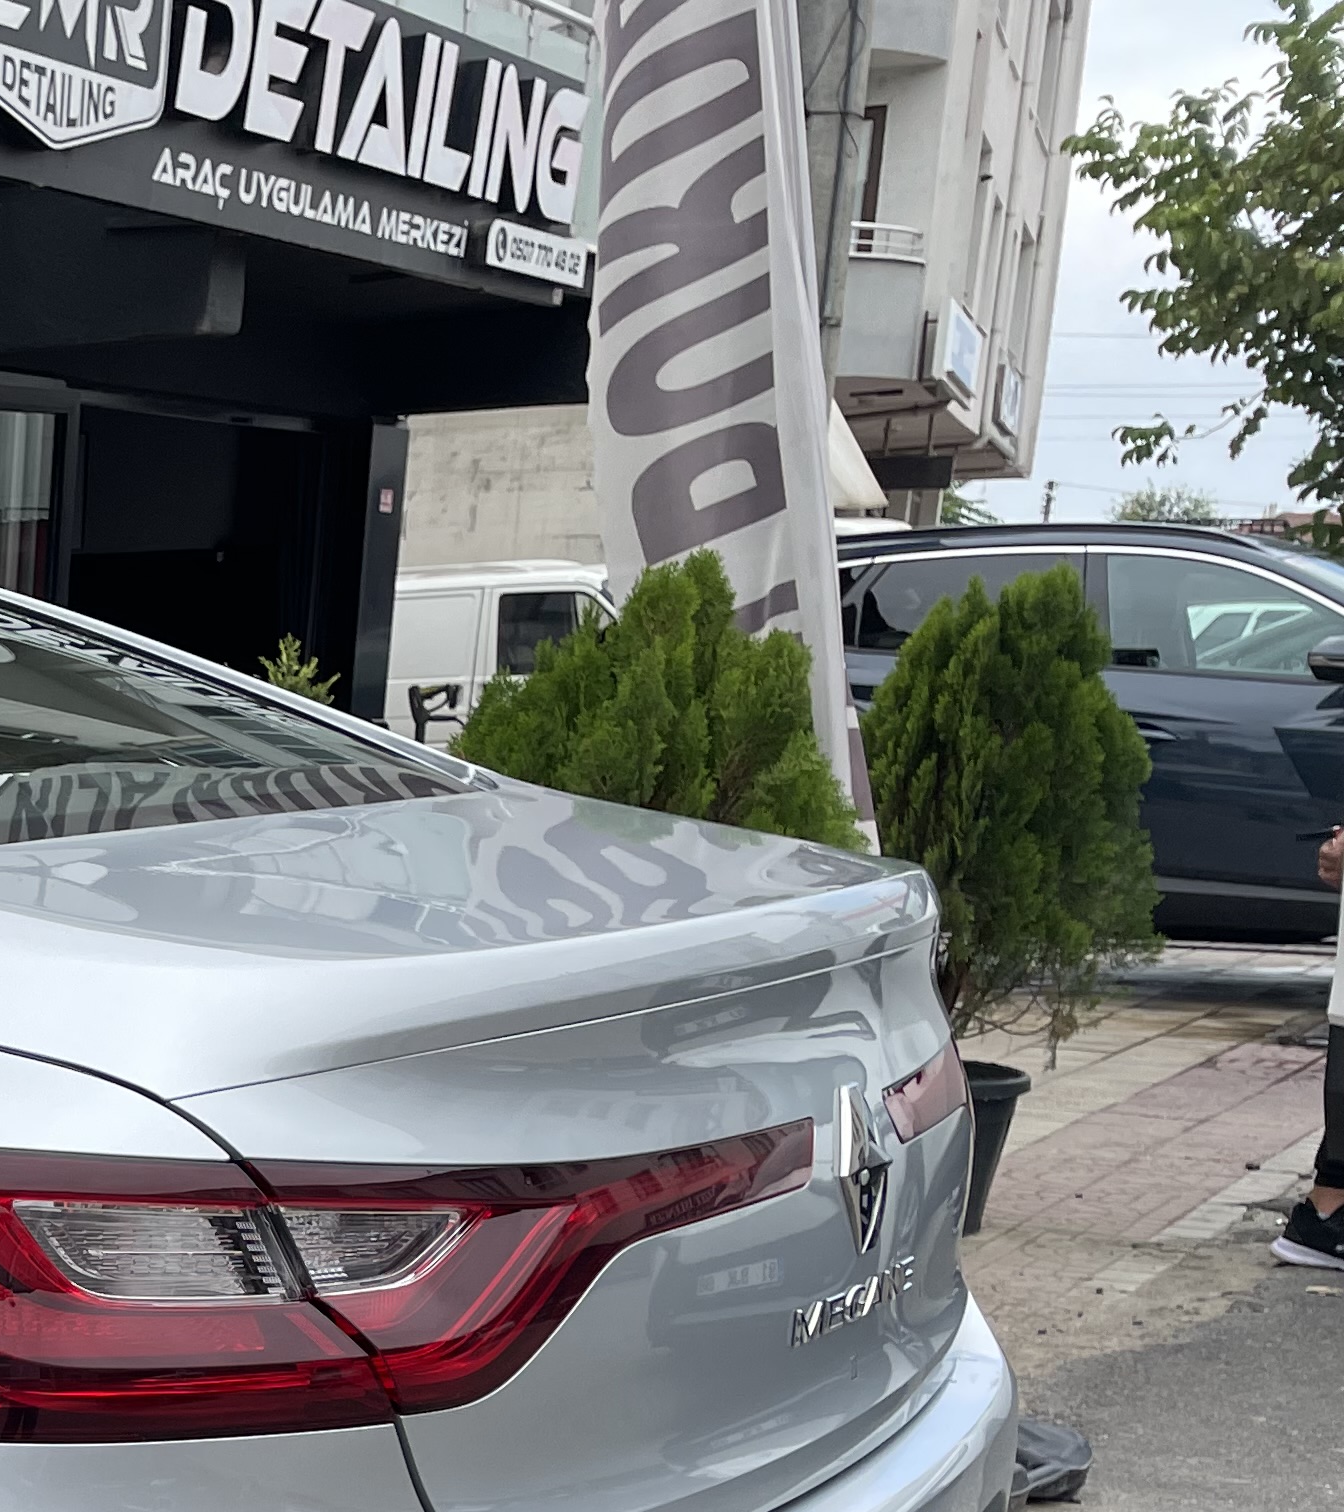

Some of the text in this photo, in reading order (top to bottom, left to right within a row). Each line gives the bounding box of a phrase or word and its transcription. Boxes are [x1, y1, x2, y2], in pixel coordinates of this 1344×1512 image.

[2, 54, 116, 129] DETAILING
[174, 0, 593, 226] DETAILING
[151, 146, 468, 259] ARAÇ UYGULAMA MERKEZİ
[790, 1255, 914, 1348] MEGANE
